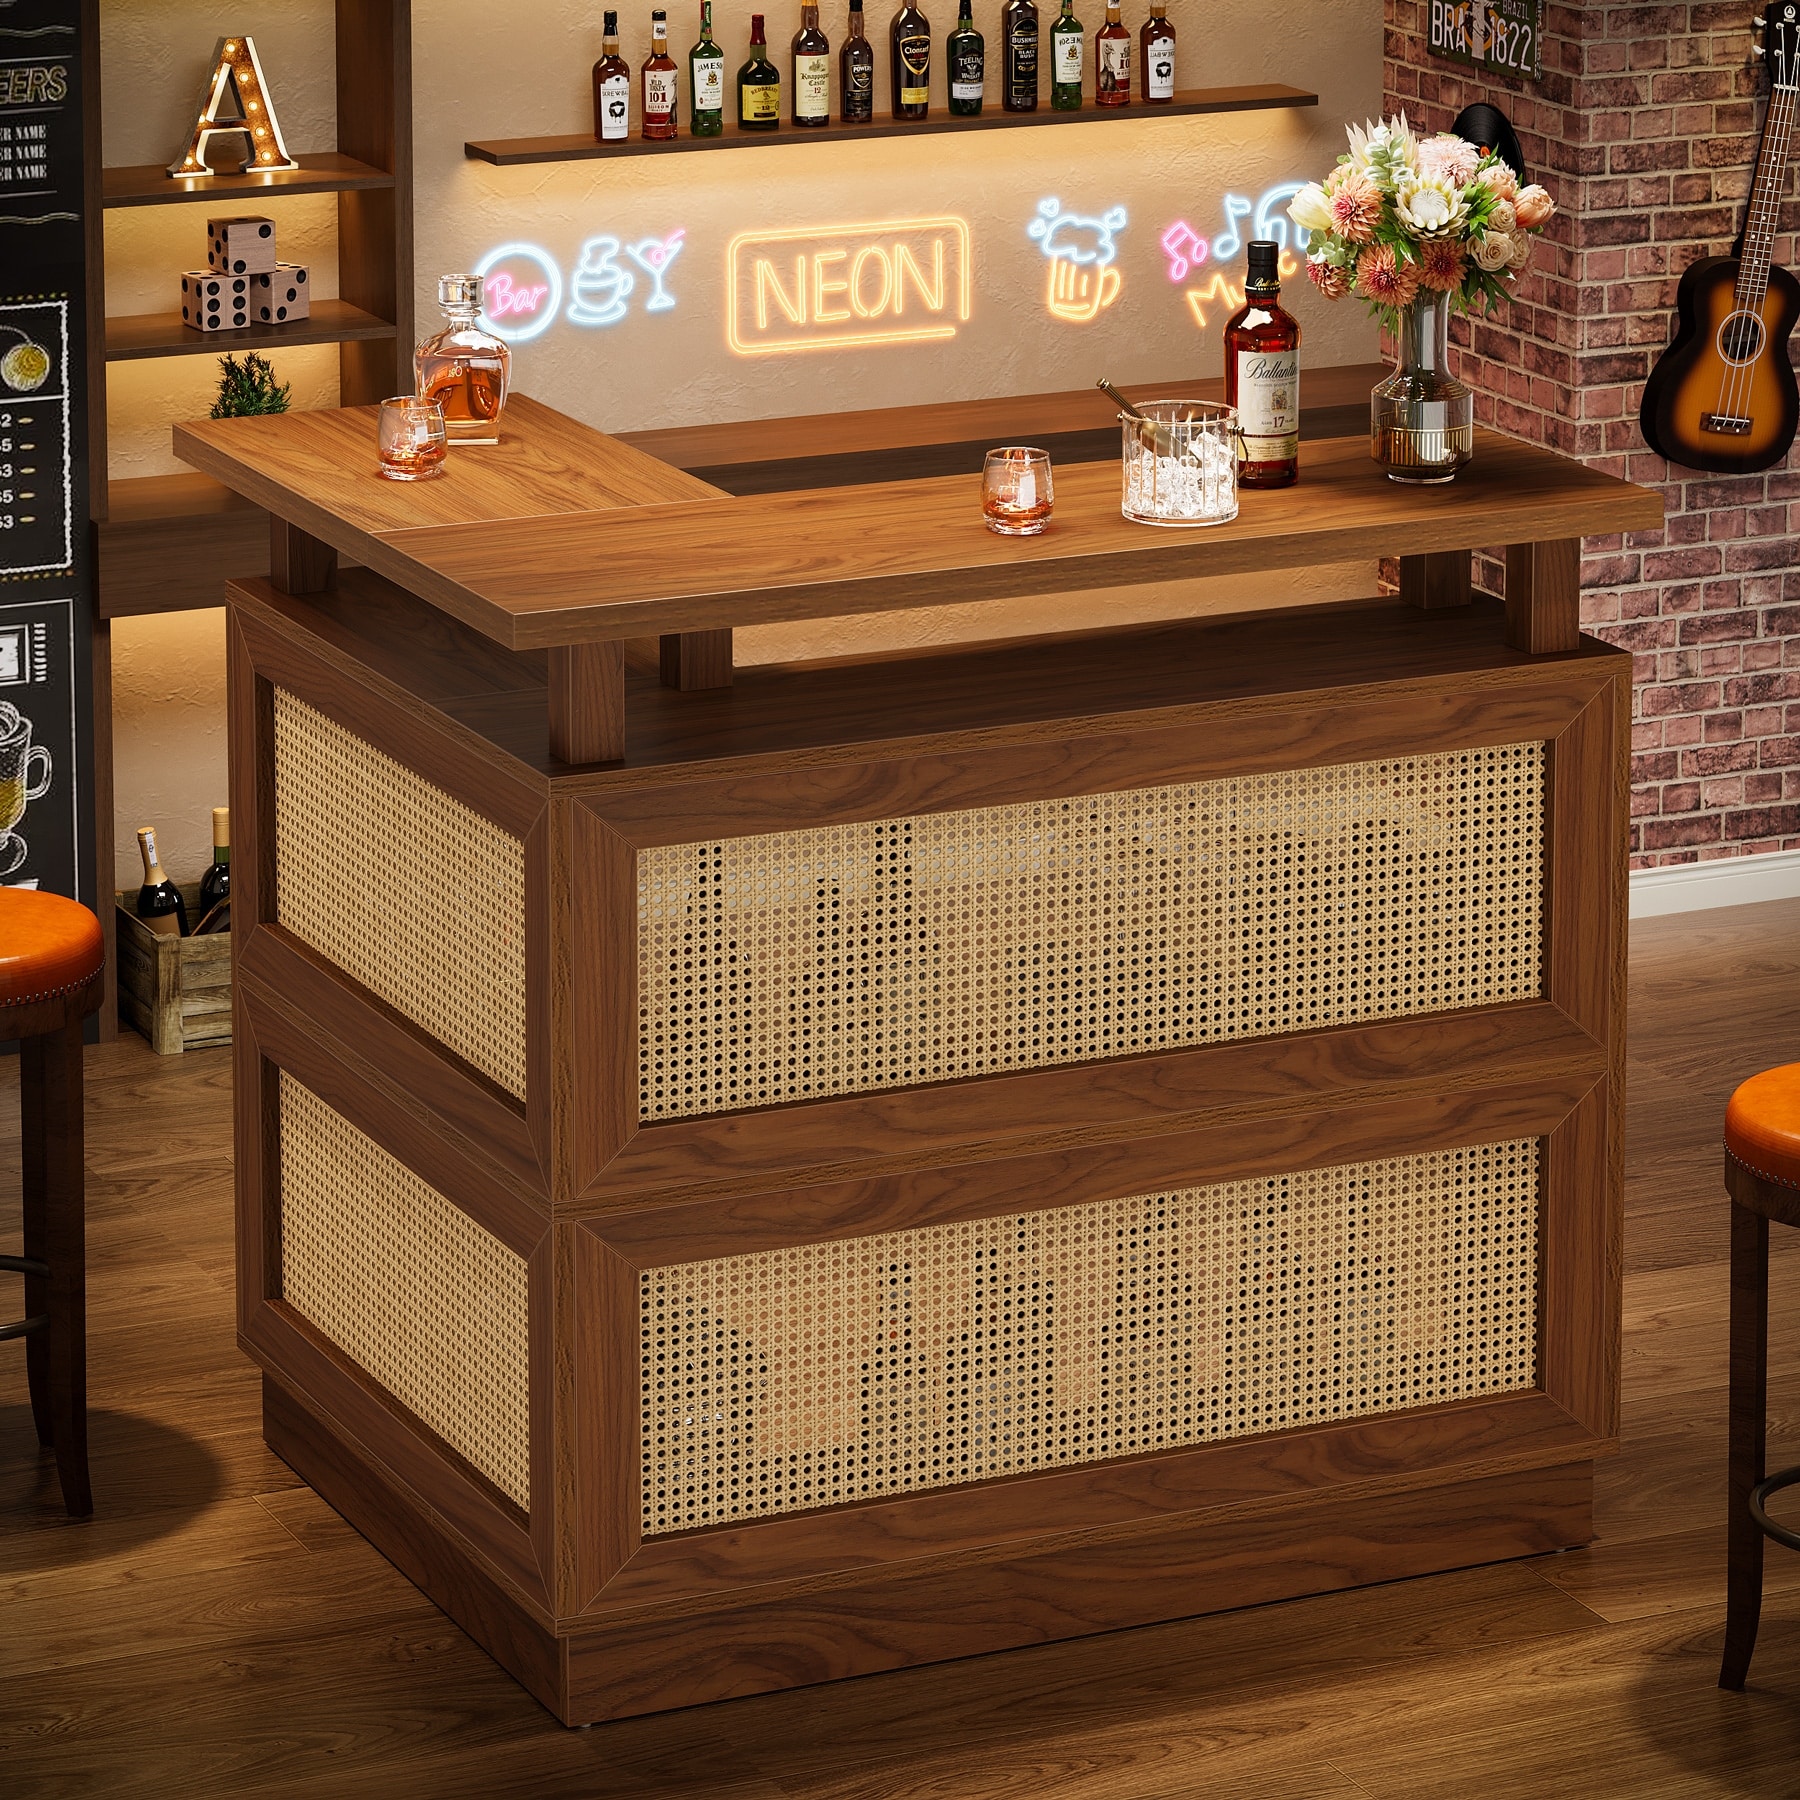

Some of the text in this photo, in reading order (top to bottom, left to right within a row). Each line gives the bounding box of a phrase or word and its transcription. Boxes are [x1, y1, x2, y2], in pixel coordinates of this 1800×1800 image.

[1502, 0, 1530, 20] BRAZIL
[1431, 0, 1533, 72] BRA 1822
[958, 56, 983, 67] TEELING
[649, 91, 668, 103] 101
[814, 86, 822, 94] 12
[166, 36, 299, 178] A
[15, 124, 47, 140] NAME
[16, 144, 47, 160] NAME
[16, 164, 48, 180] NAME
[757, 240, 943, 328] NEON
[487, 274, 548, 318] Bar
[1273, 415, 1285, 429] 17
